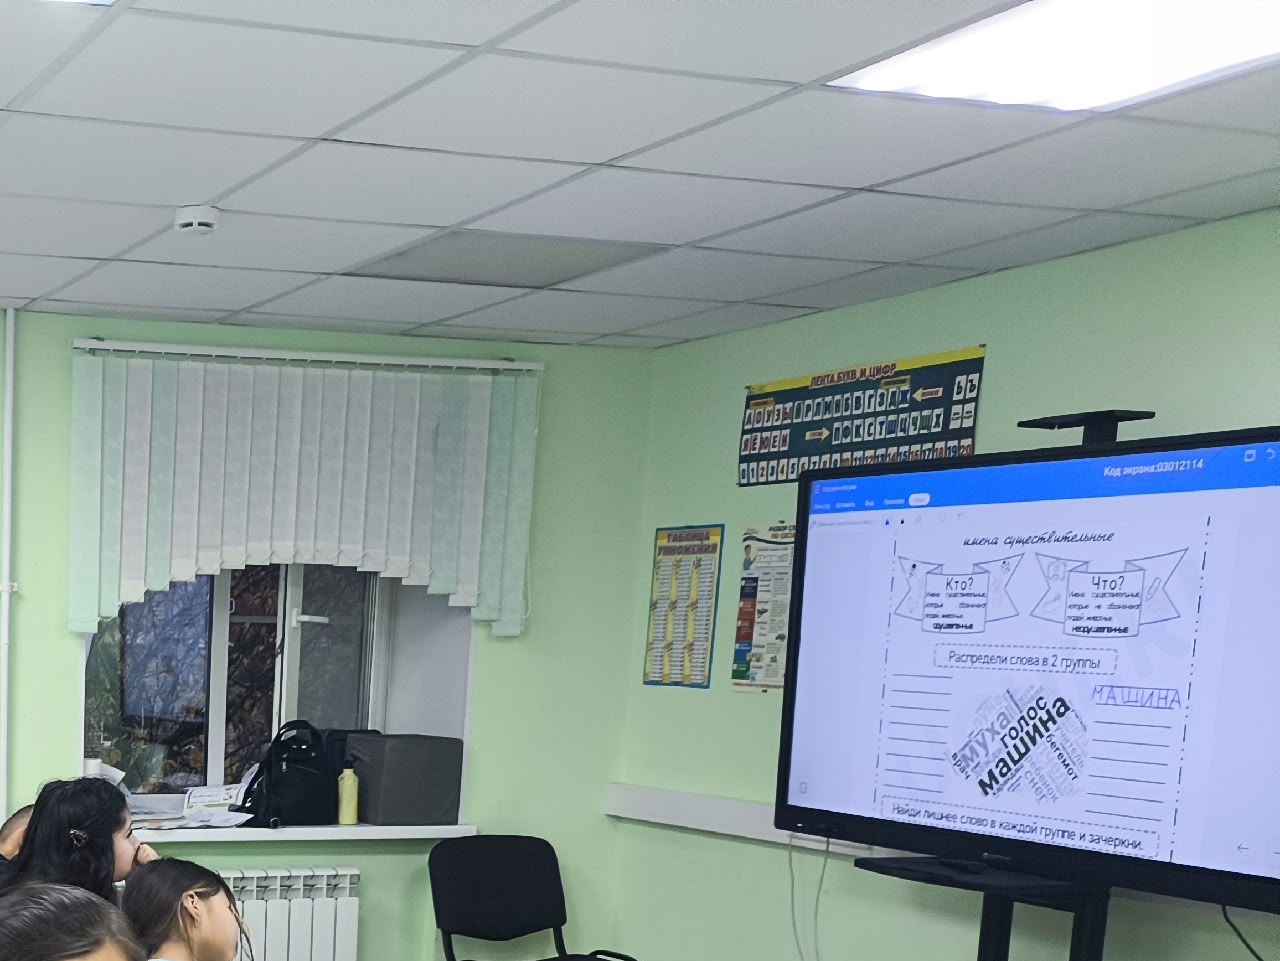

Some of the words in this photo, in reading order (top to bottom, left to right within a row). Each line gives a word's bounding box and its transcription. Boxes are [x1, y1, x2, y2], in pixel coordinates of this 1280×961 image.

[811, 374, 834, 386] ЛЕНТА
[837, 369, 857, 382] БУКВ
[860, 367, 867, 379] И
[869, 363, 897, 378] ЦИФР
[1104, 466, 1121, 477] Код
[963, 537, 999, 546] имена
[1004, 531, 1115, 549] существительные
[946, 577, 974, 591] Кто?
[1091, 576, 1125, 591] Что?
[949, 650, 1008, 666] Распредели
[1010, 655, 1040, 666] слова
[1042, 657, 1049, 666] в
[1051, 654, 1058, 667] 2
[1061, 658, 1101, 671] группы
[1091, 684, 1182, 709] МАШИНА
[999, 695, 1048, 750] голос
[959, 711, 1012, 768] муха
[977, 696, 1072, 797] машина
[951, 751, 971, 781] врач
[1045, 733, 1079, 781] бегемот
[893, 803, 921, 818] Найди
[922, 809, 958, 824] лишнее
[960, 815, 989, 829] слово
[999, 821, 1038, 835] каждой
[1040, 827, 1076, 842] группе
[1088, 833, 1143, 850] зачеркни.
